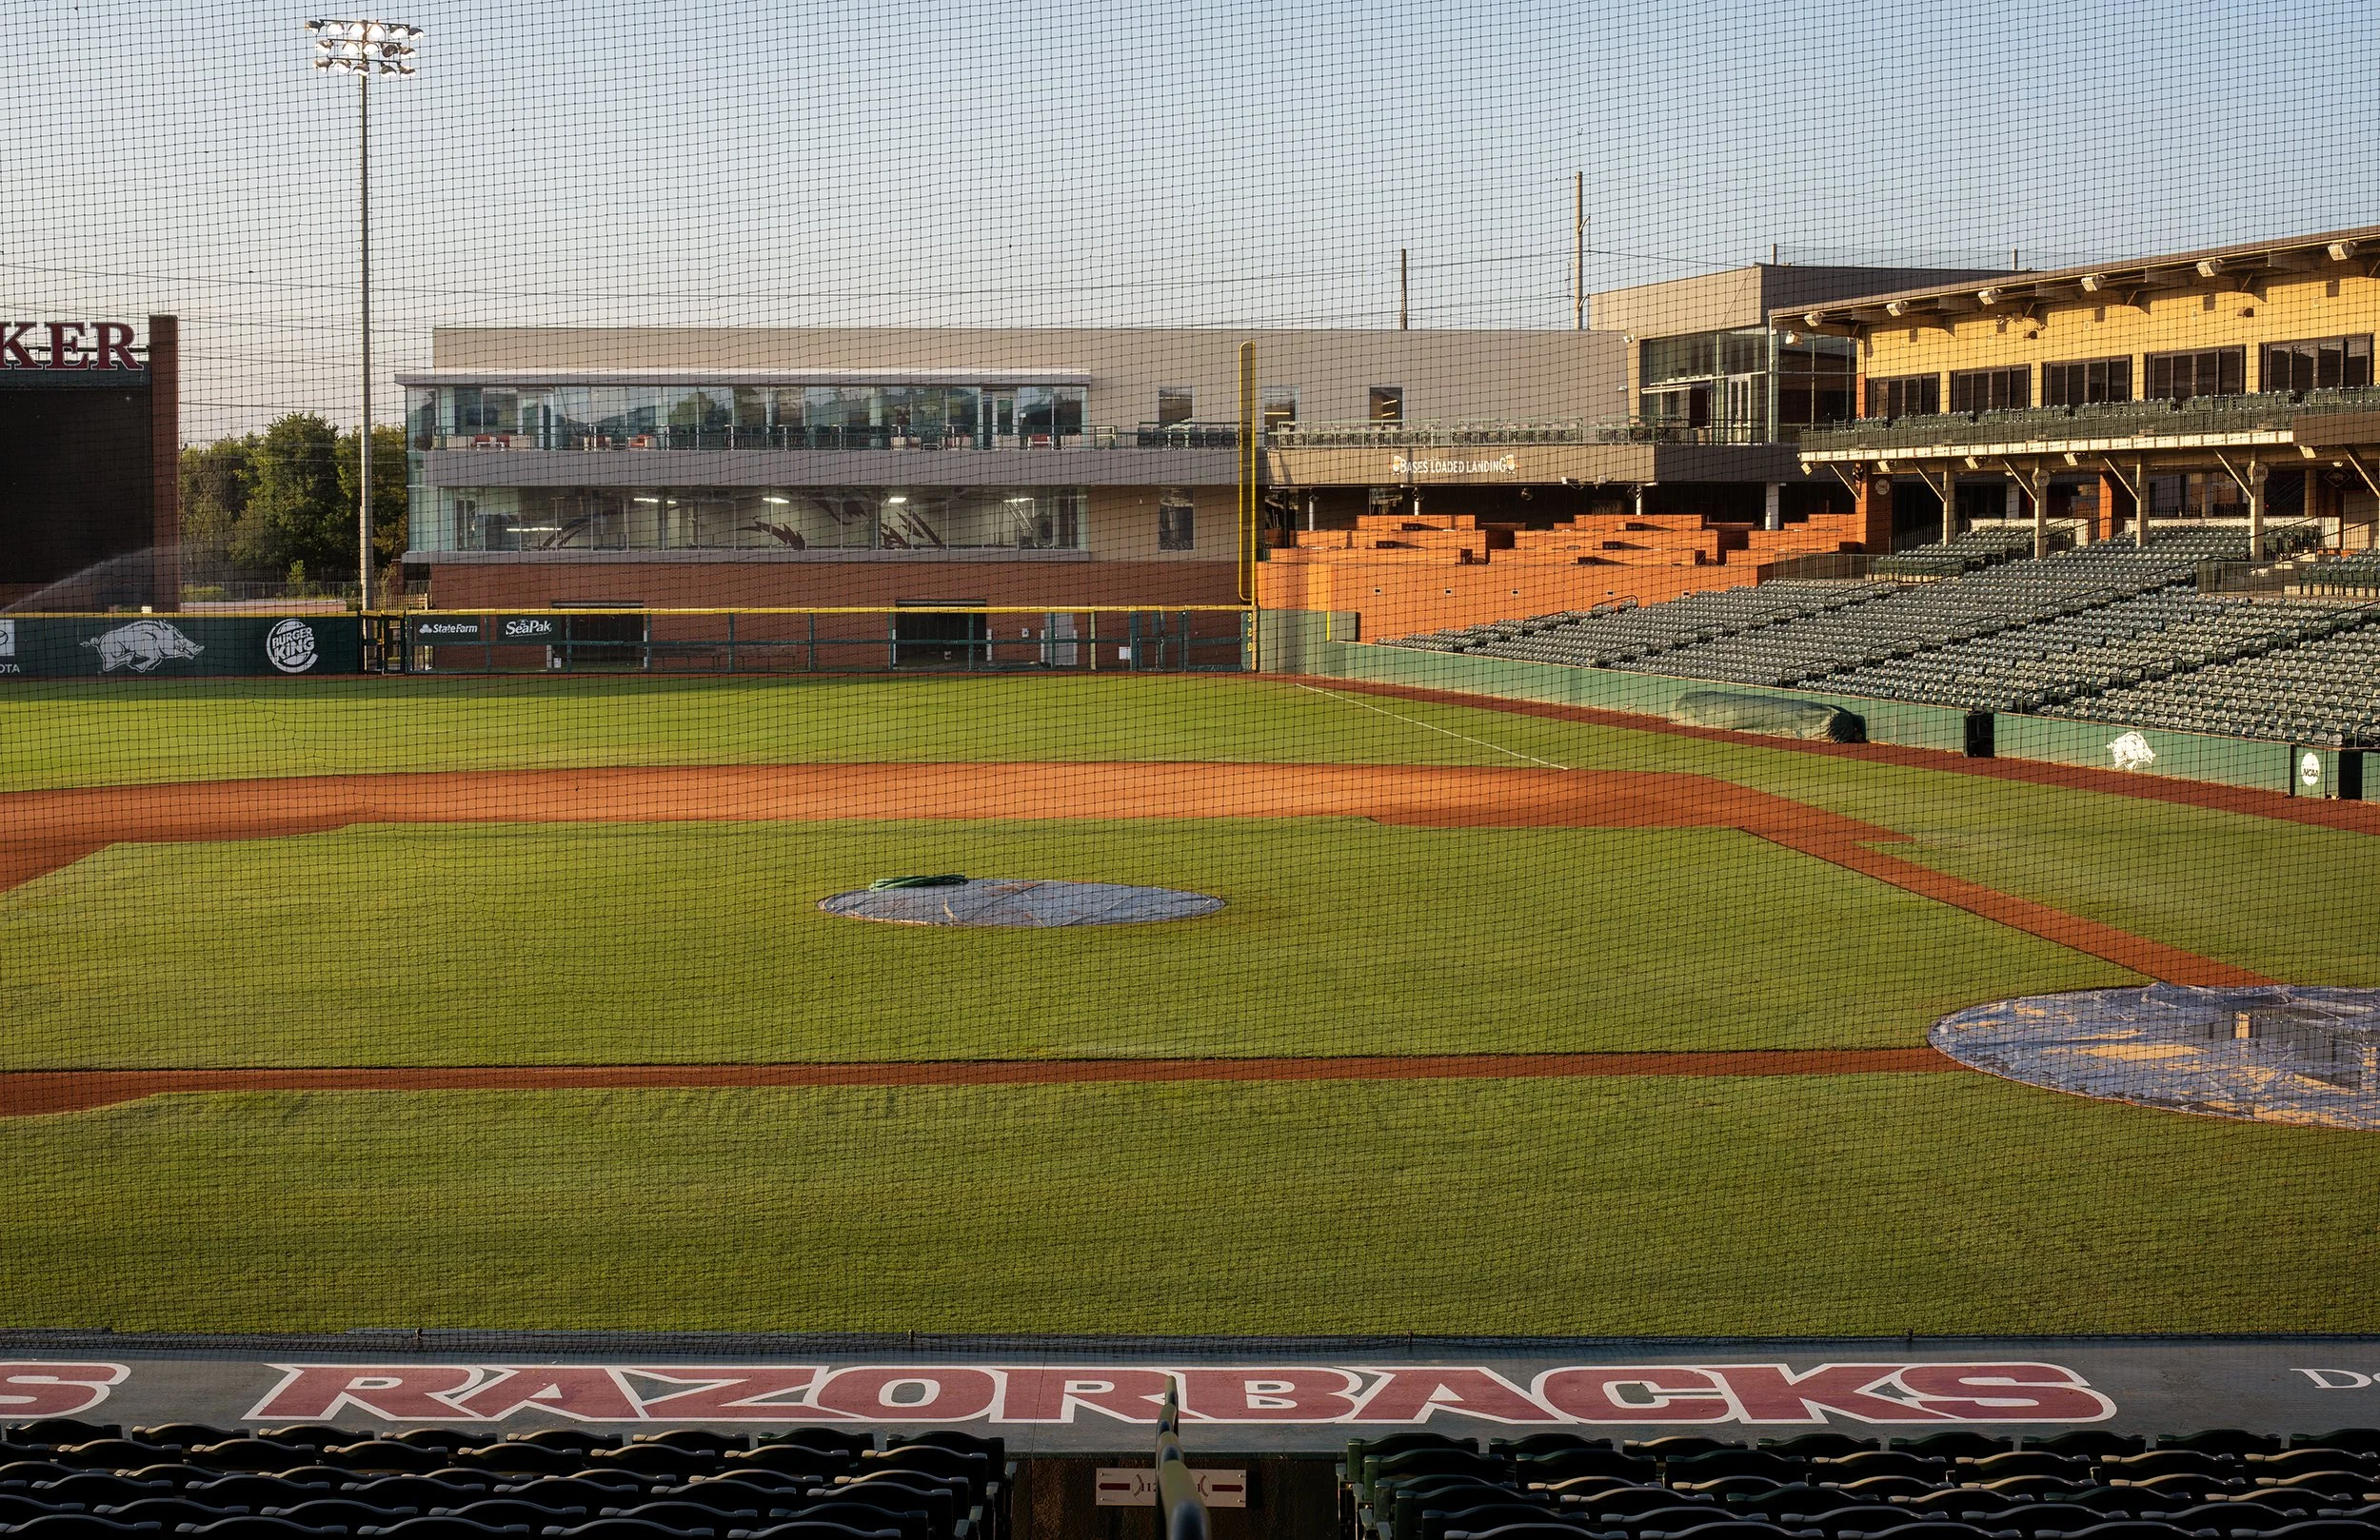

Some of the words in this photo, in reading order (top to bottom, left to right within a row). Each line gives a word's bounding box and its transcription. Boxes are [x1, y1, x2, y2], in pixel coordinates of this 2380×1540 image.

[0, 321, 145, 371] KER
[1399, 459, 1428, 473] BASES
[1431, 460, 1464, 473] LOADED
[1466, 457, 1506, 473] LANDING
[271, 626, 313, 649] BURGER
[506, 620, 552, 635] SeaPak
[273, 636, 315, 661] KING
[240, 1361, 2117, 1425] RAZORBACKS
[2290, 1368, 2380, 1389] D
